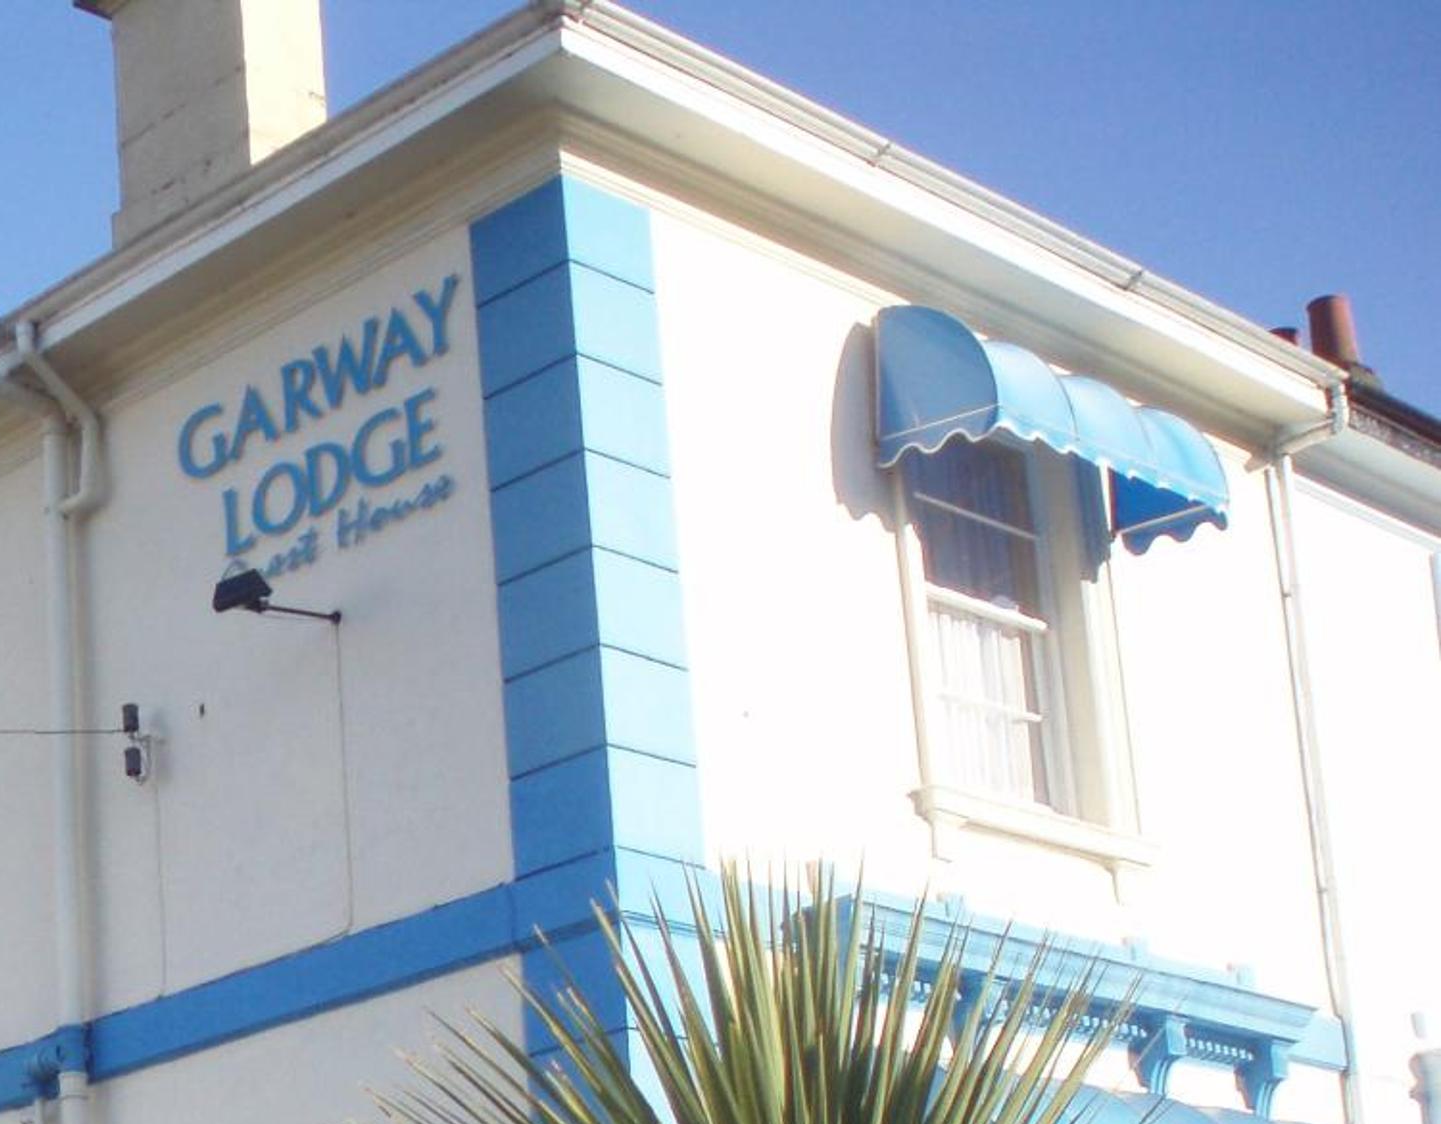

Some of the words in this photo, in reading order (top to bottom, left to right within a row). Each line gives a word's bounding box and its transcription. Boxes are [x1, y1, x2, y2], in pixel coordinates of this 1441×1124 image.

[178, 273, 459, 479] GARWAY
[222, 386, 445, 557] LODGE
[336, 473, 455, 549] House
